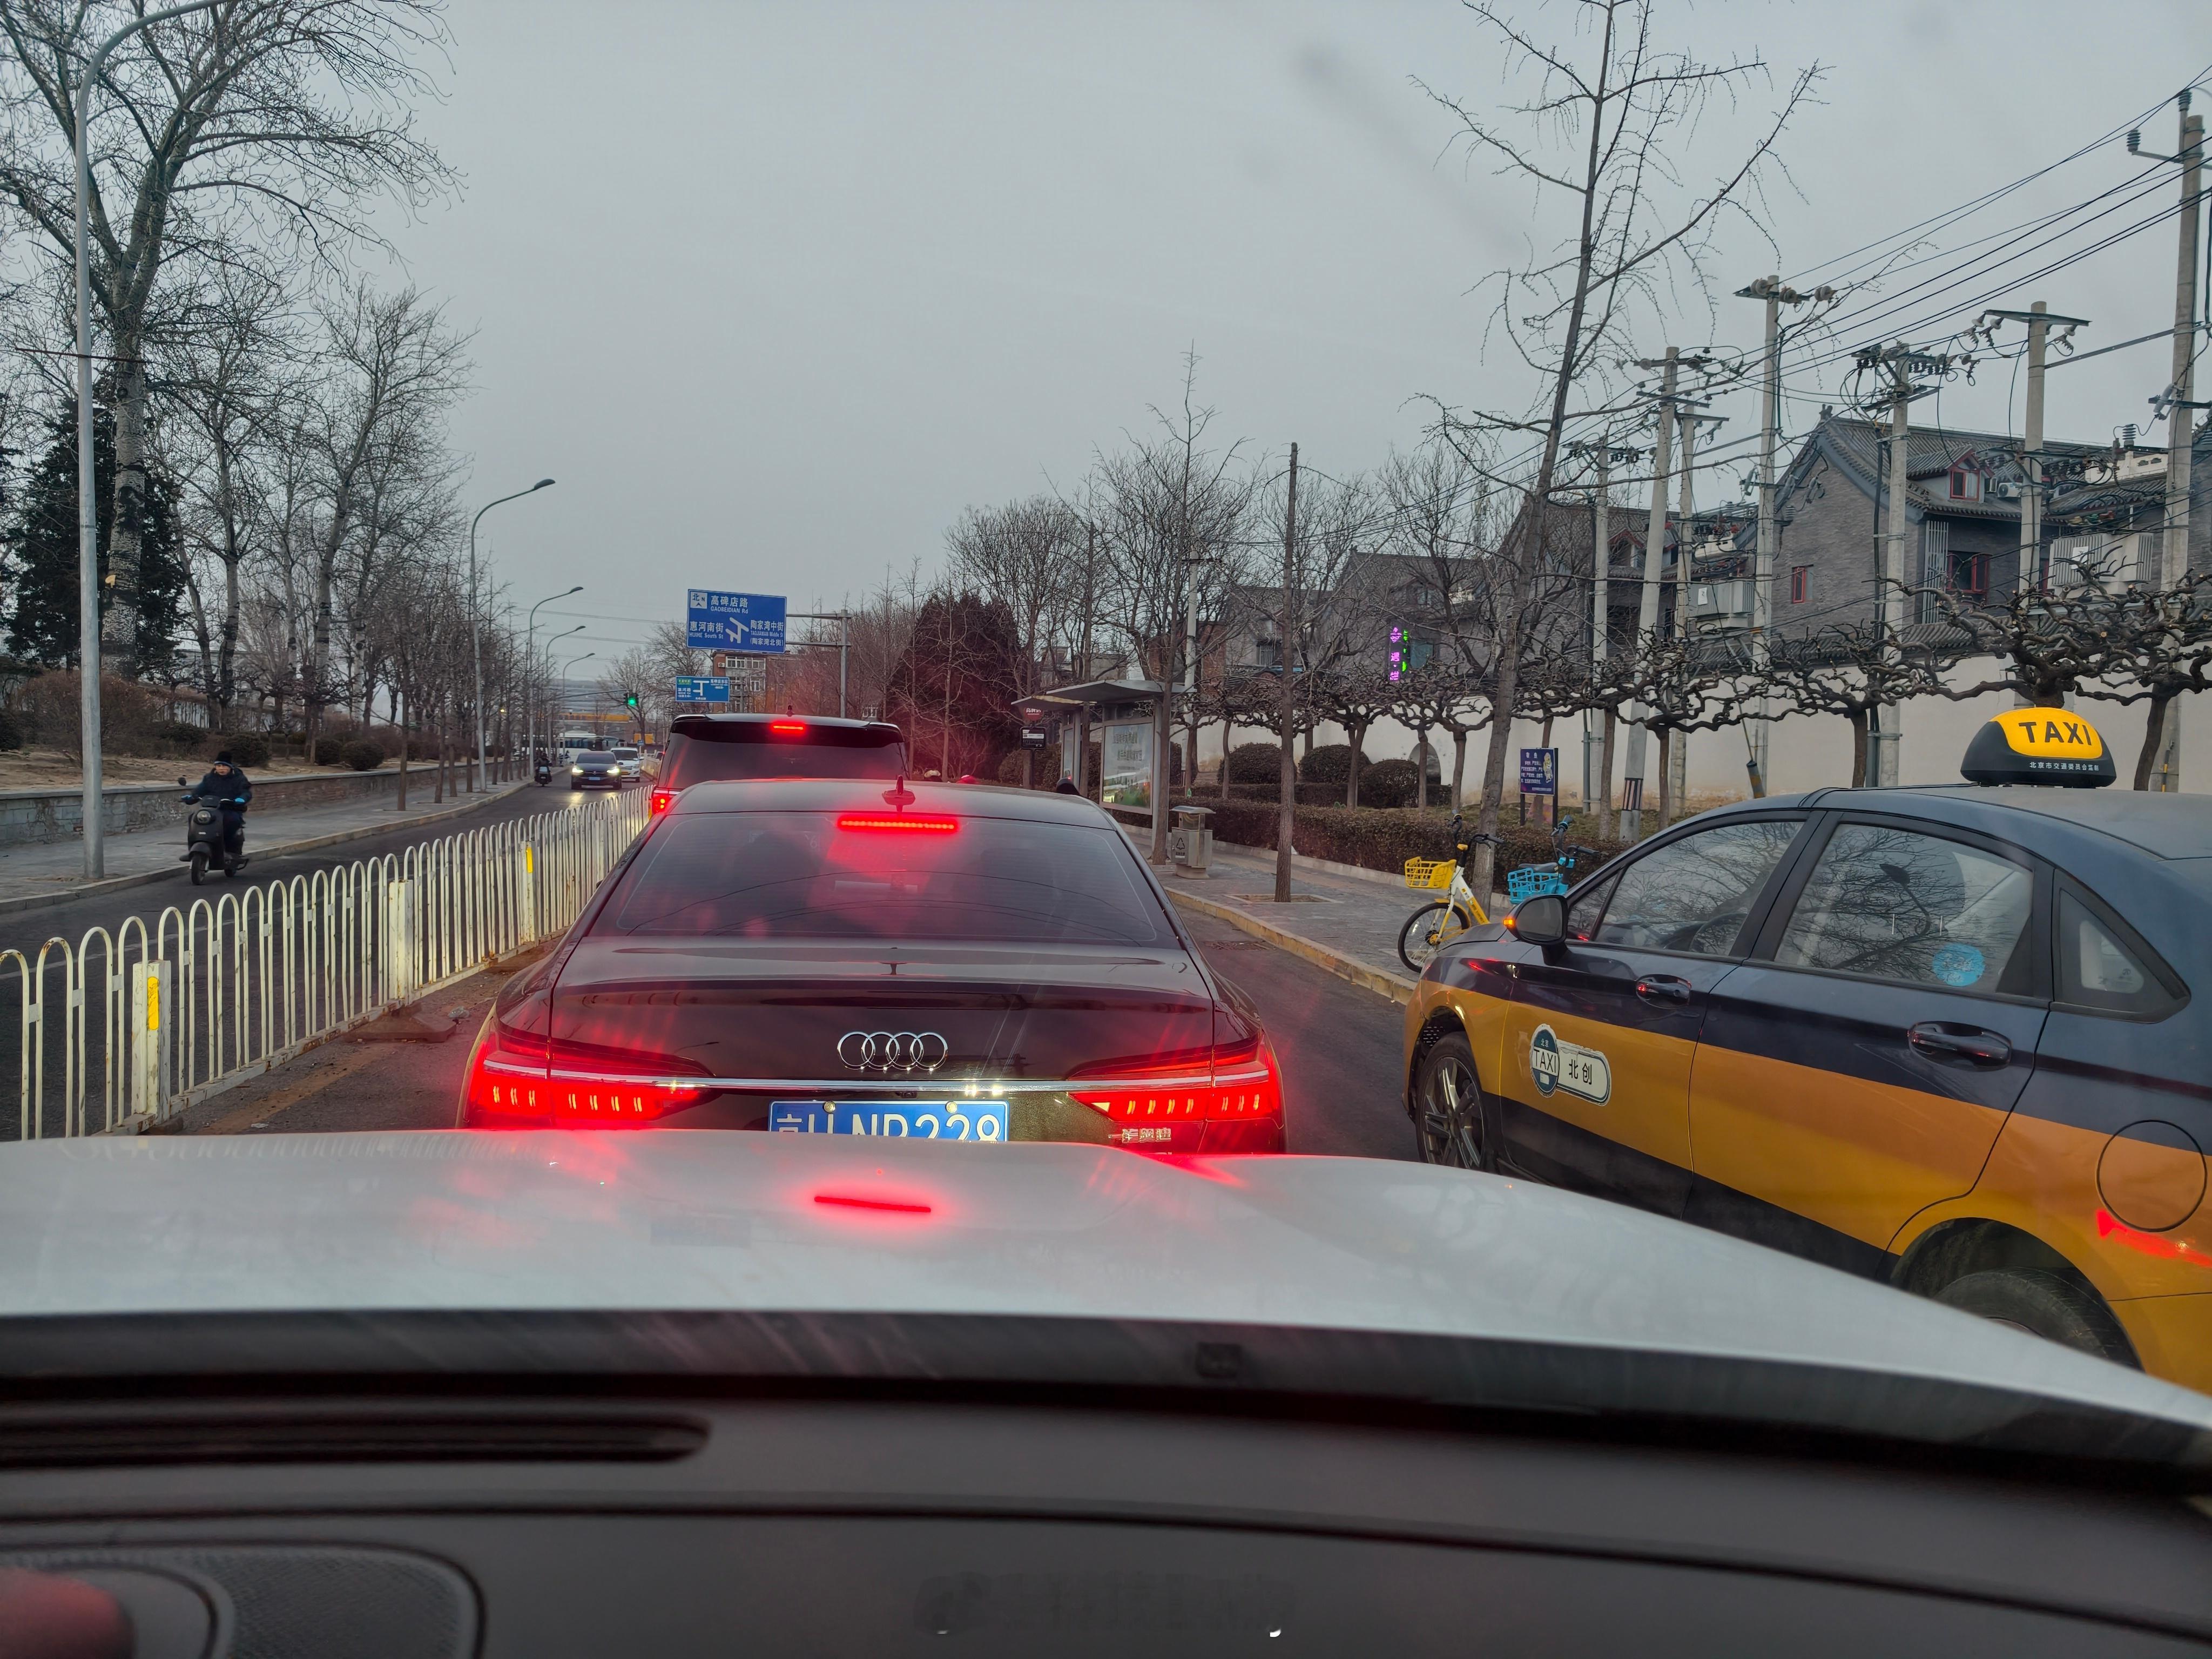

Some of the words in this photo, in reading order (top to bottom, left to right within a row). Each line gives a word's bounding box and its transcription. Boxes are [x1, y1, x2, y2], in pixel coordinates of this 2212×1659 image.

[692, 593, 700, 601] 北
[711, 595, 747, 608] 高碑店路
[690, 621, 724, 632] 惠河南街
[2019, 721, 2092, 745] TAXI
[1534, 1048, 1556, 1073] TAXI
[1569, 1059, 1592, 1084] 北创
